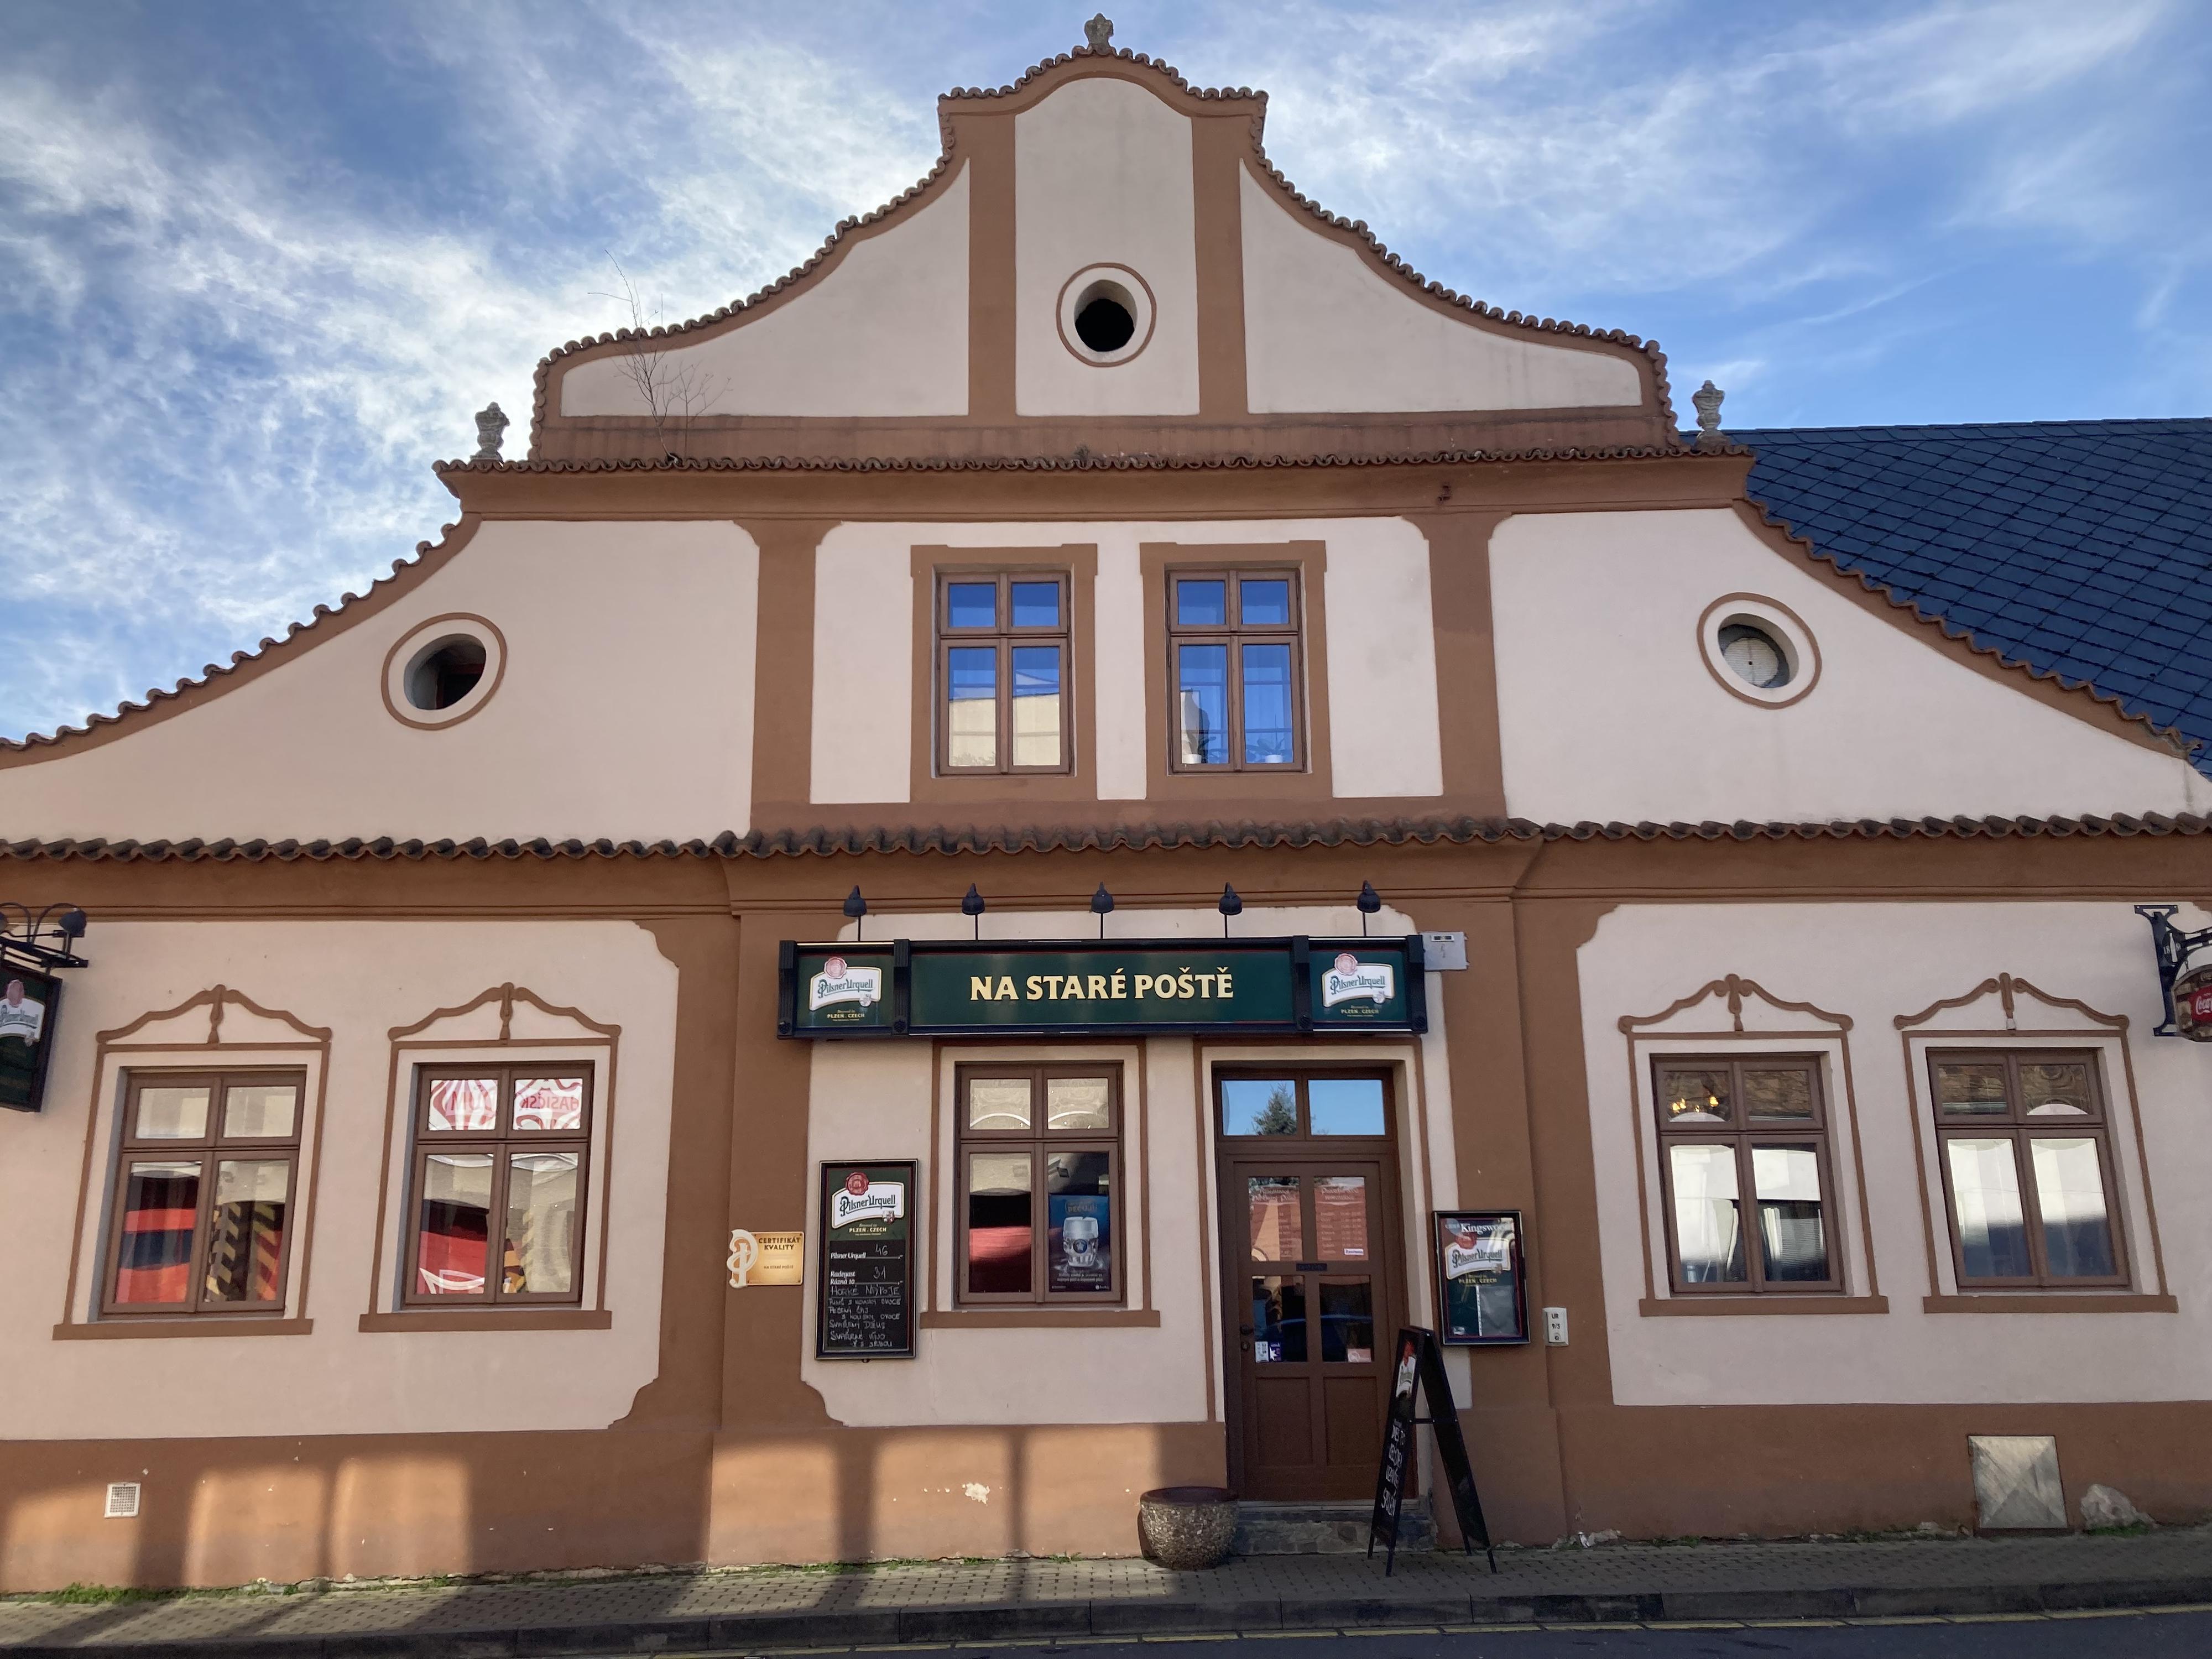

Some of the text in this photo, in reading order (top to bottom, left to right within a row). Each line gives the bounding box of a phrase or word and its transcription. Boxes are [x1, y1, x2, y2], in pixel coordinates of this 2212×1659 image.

[817, 978, 873, 999] Pilsner Urquell
[970, 967, 1234, 1000] NA STARÉ POŠTĚ
[1330, 975, 1385, 995] Pilsner Urquell
[839, 1194, 896, 1217] Pilsner Urquell
[848, 1252, 867, 1260] Urquell
[875, 1244, 888, 1256] 46
[1452, 1249, 1503, 1269] Pilsner Urquell
[830, 1270, 855, 1279] Radegast
[874, 1265, 886, 1279] 31
